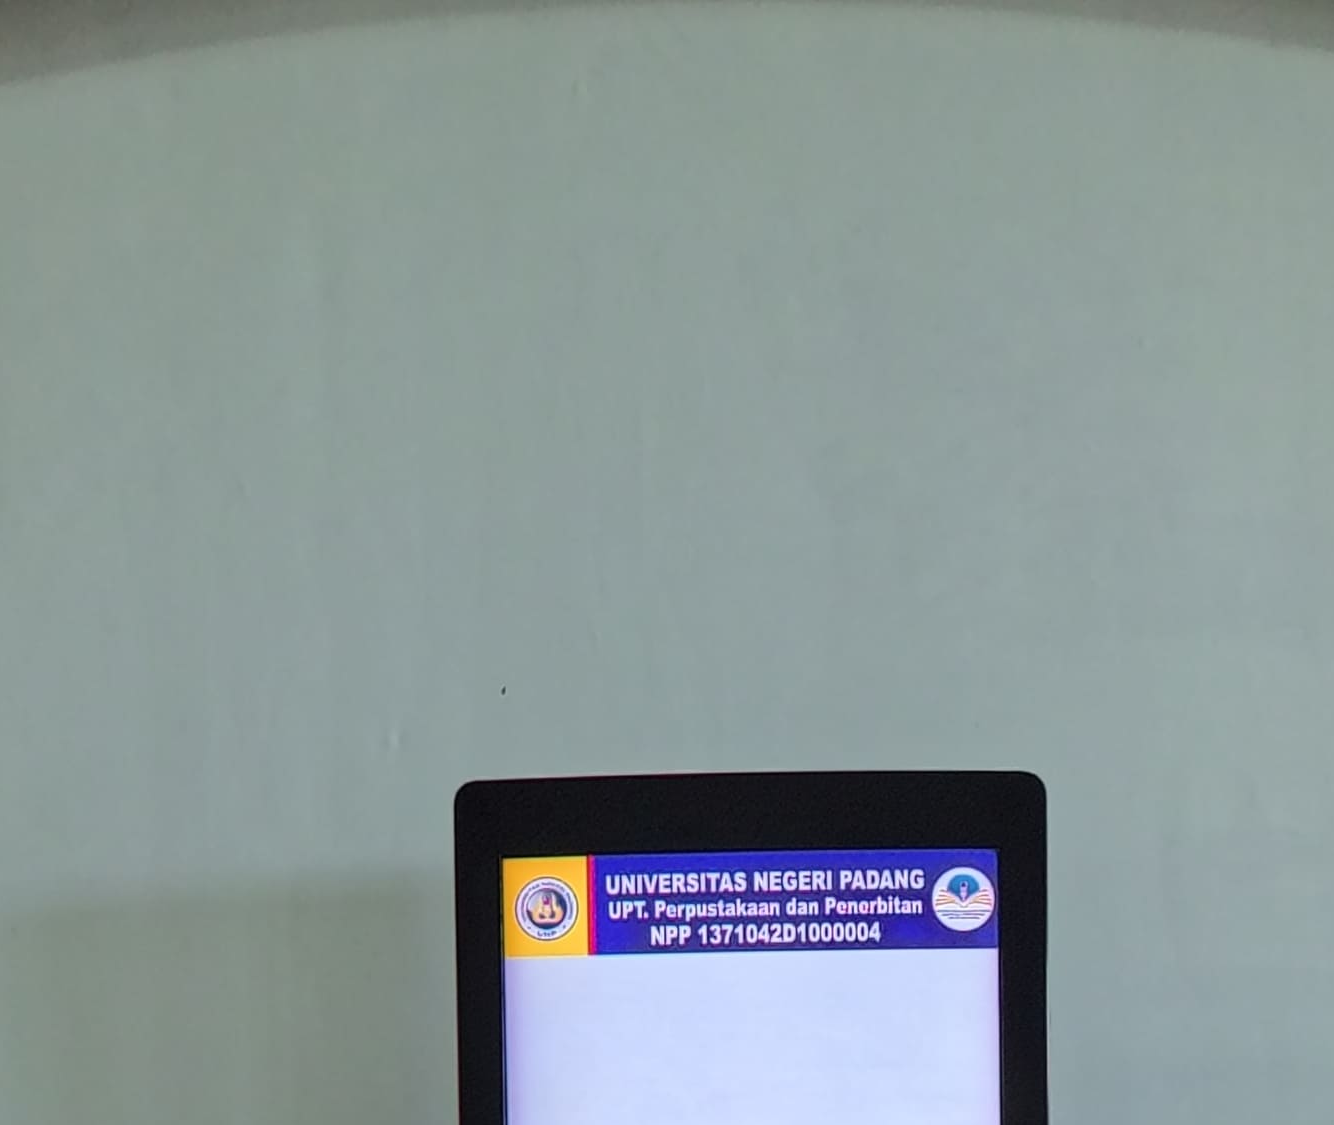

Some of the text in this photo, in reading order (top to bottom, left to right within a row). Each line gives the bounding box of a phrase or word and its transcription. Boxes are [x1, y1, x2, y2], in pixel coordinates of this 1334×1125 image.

[605, 868, 925, 895] UNIVERSITAS NEGERI PADANG
[607, 901, 649, 920] UPT.
[654, 899, 780, 921] Perpustakaan
[785, 899, 819, 917] dan
[825, 898, 923, 917] Penerbitan
[650, 921, 882, 946] NPP 1371042D1000004
